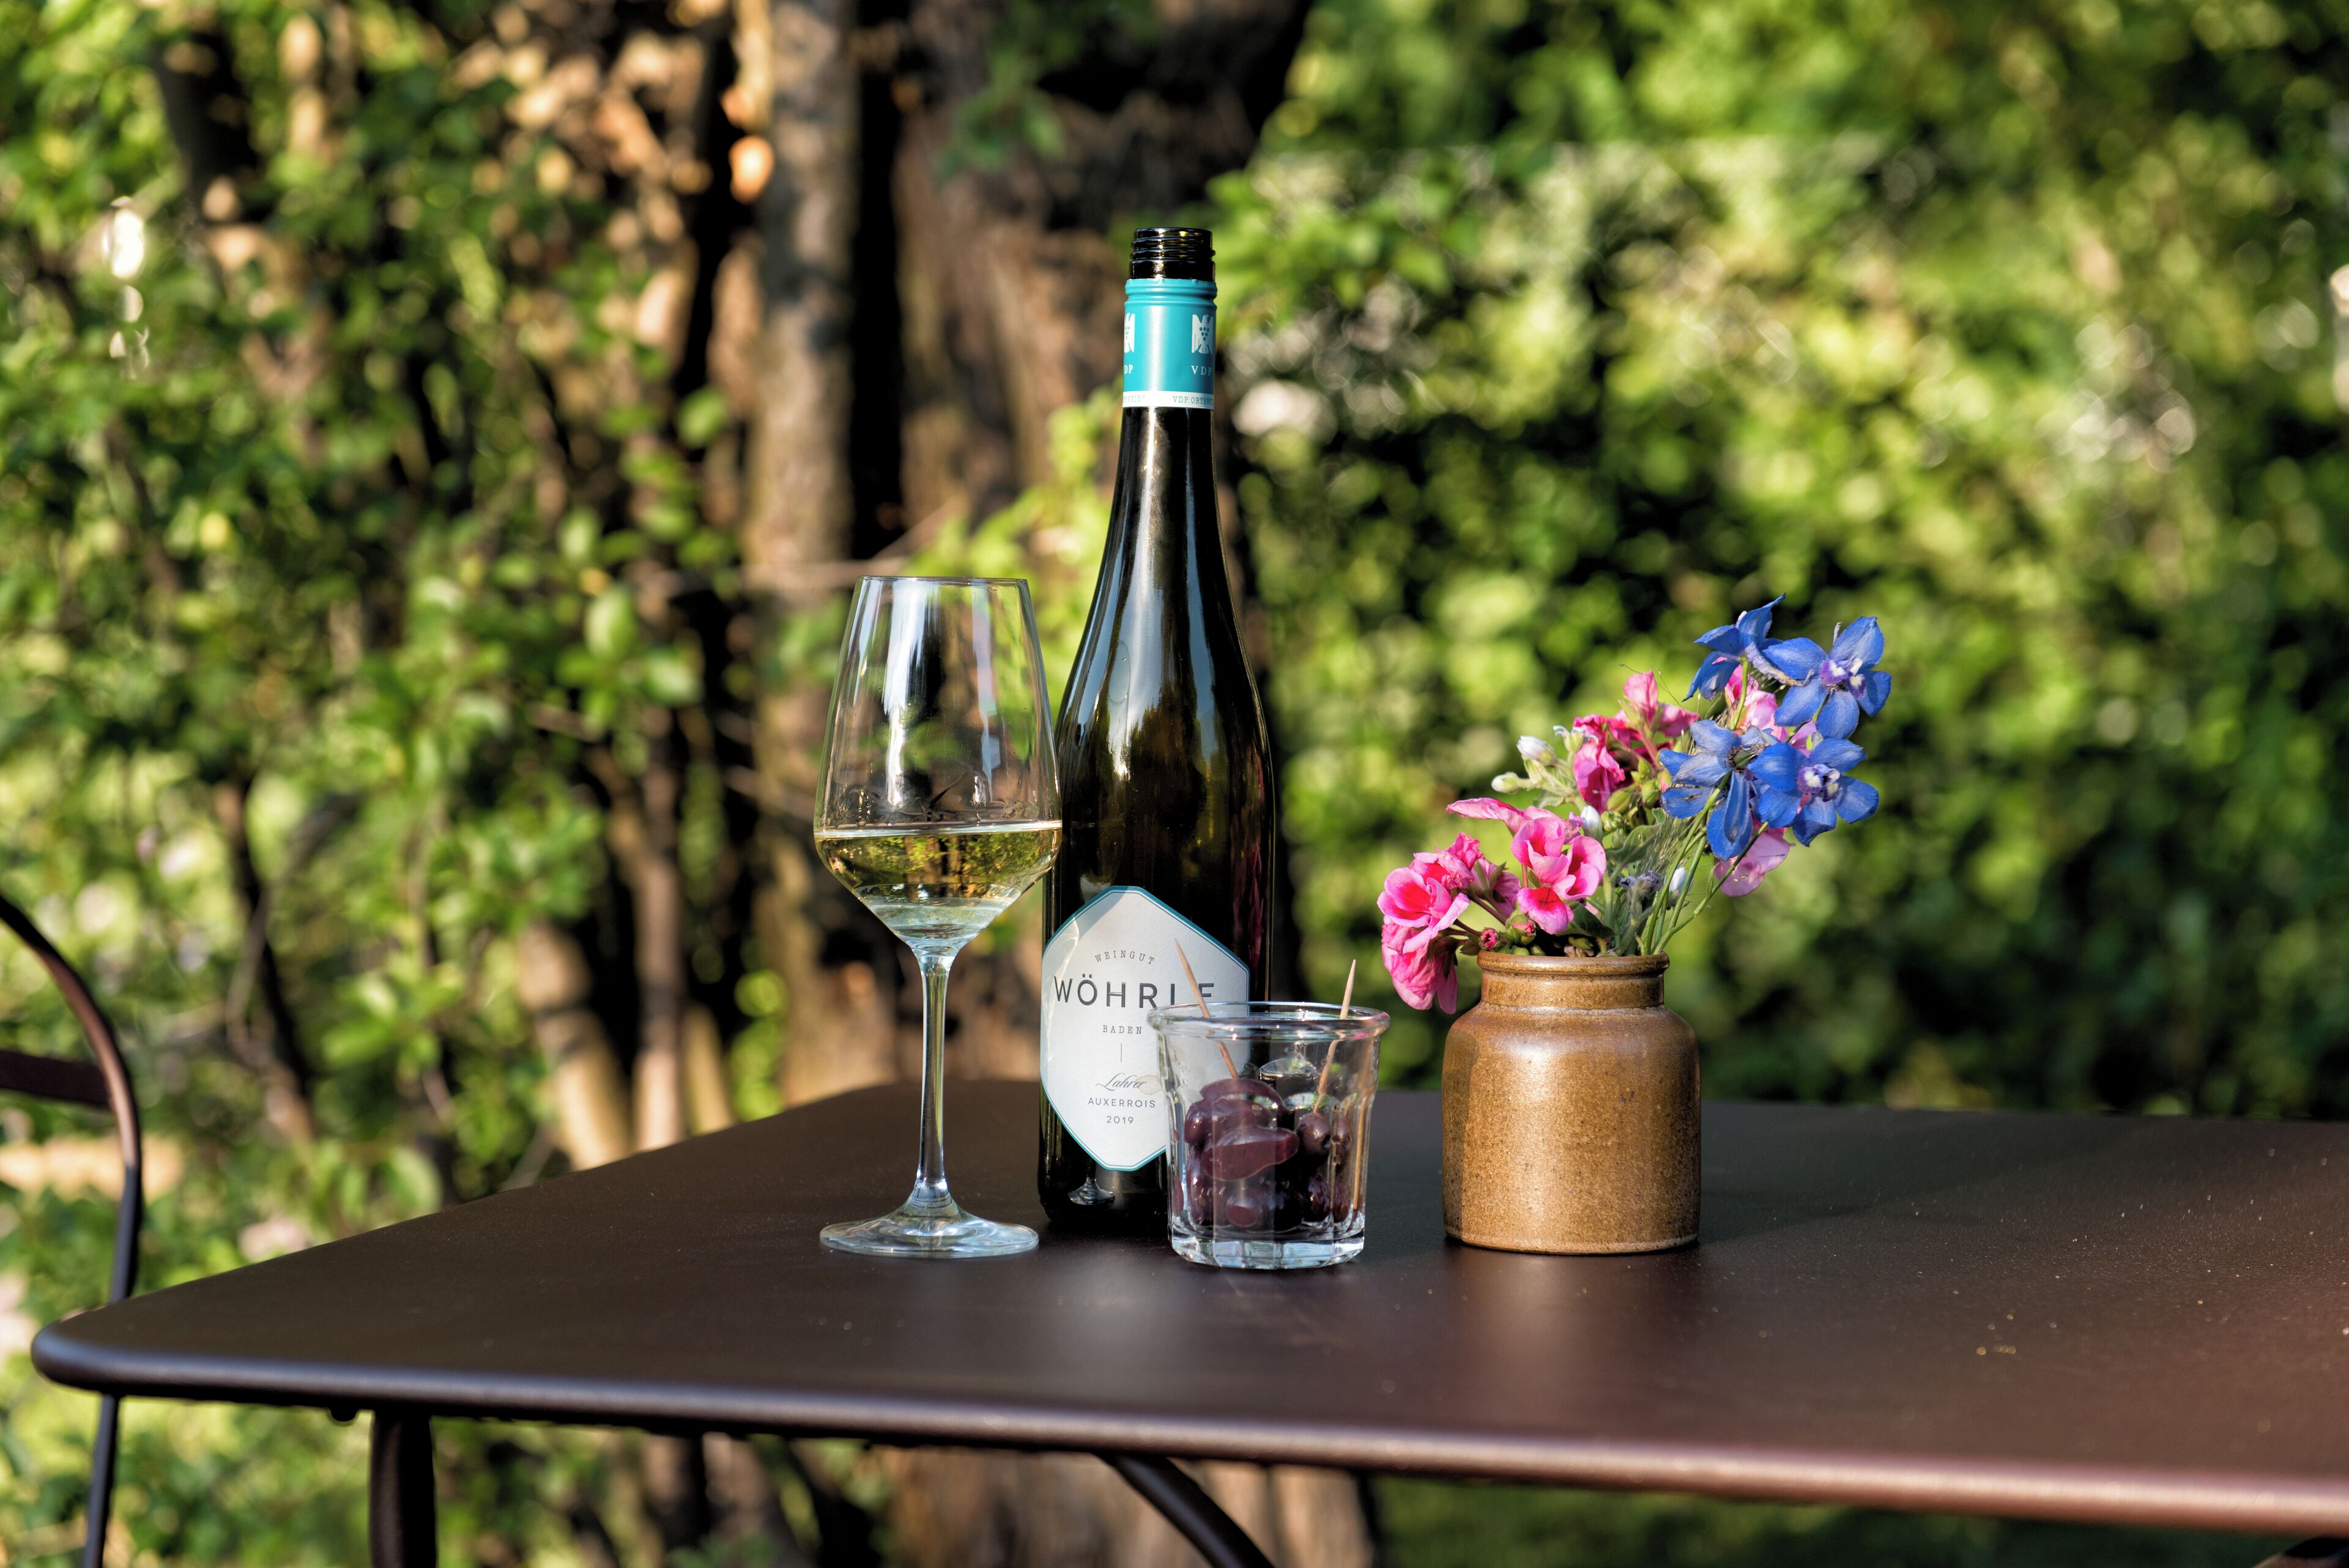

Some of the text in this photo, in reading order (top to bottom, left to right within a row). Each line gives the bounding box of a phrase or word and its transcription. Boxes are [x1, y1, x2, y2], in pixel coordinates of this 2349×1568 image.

[1191, 365, 1212, 376] VDP
[1094, 950, 1155, 965] WEINGUT
[1102, 1025, 1143, 1035] BADEN
[1096, 1072, 1147, 1091] Lahrer
[1088, 1097, 1156, 1108] AUXERROIS
[1106, 1115, 1134, 1124] 2019
